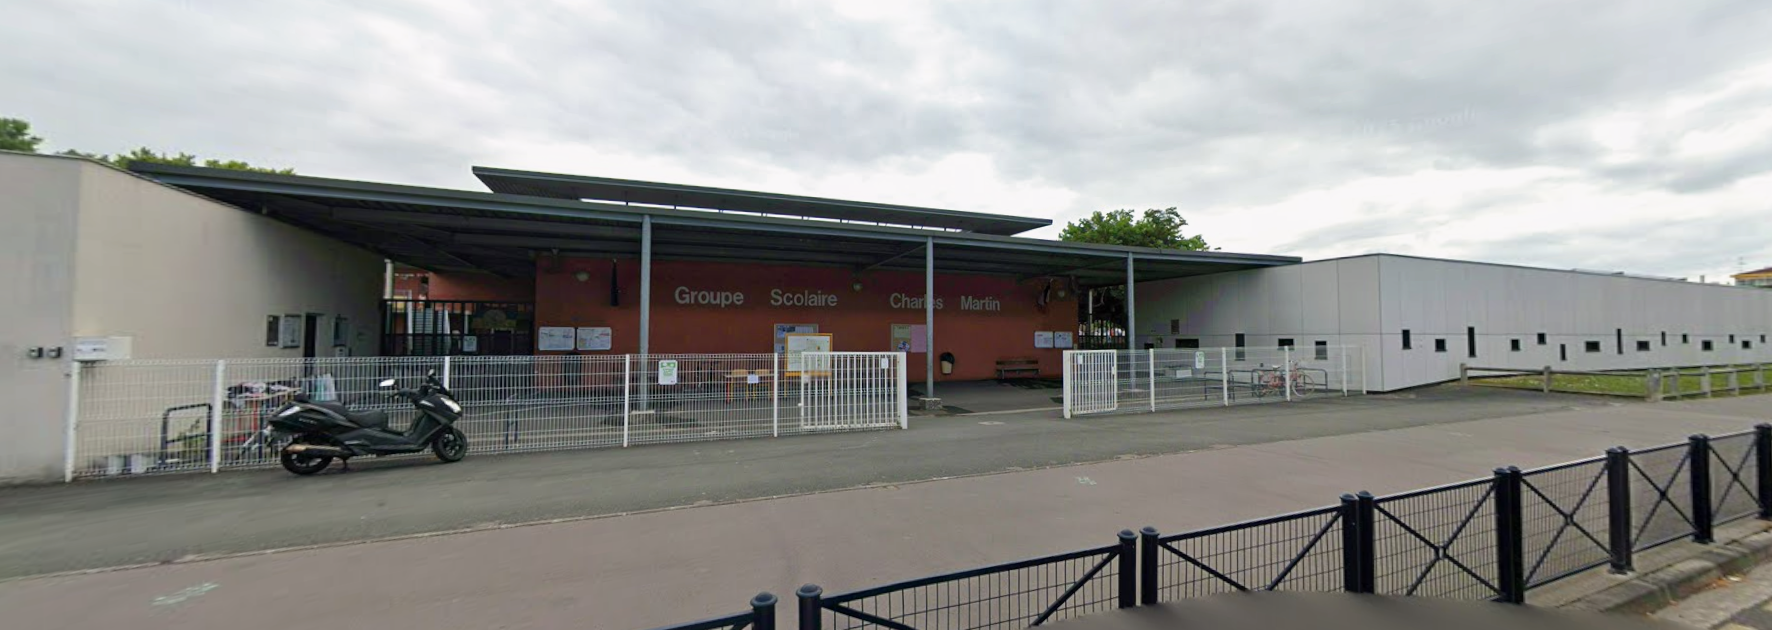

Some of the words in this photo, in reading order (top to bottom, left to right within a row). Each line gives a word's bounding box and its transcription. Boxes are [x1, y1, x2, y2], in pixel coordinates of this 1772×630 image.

[674, 286, 744, 307] Groupe
[770, 288, 838, 307] Scolaire
[890, 292, 943, 310] Charls
[960, 295, 1000, 312] Martin
